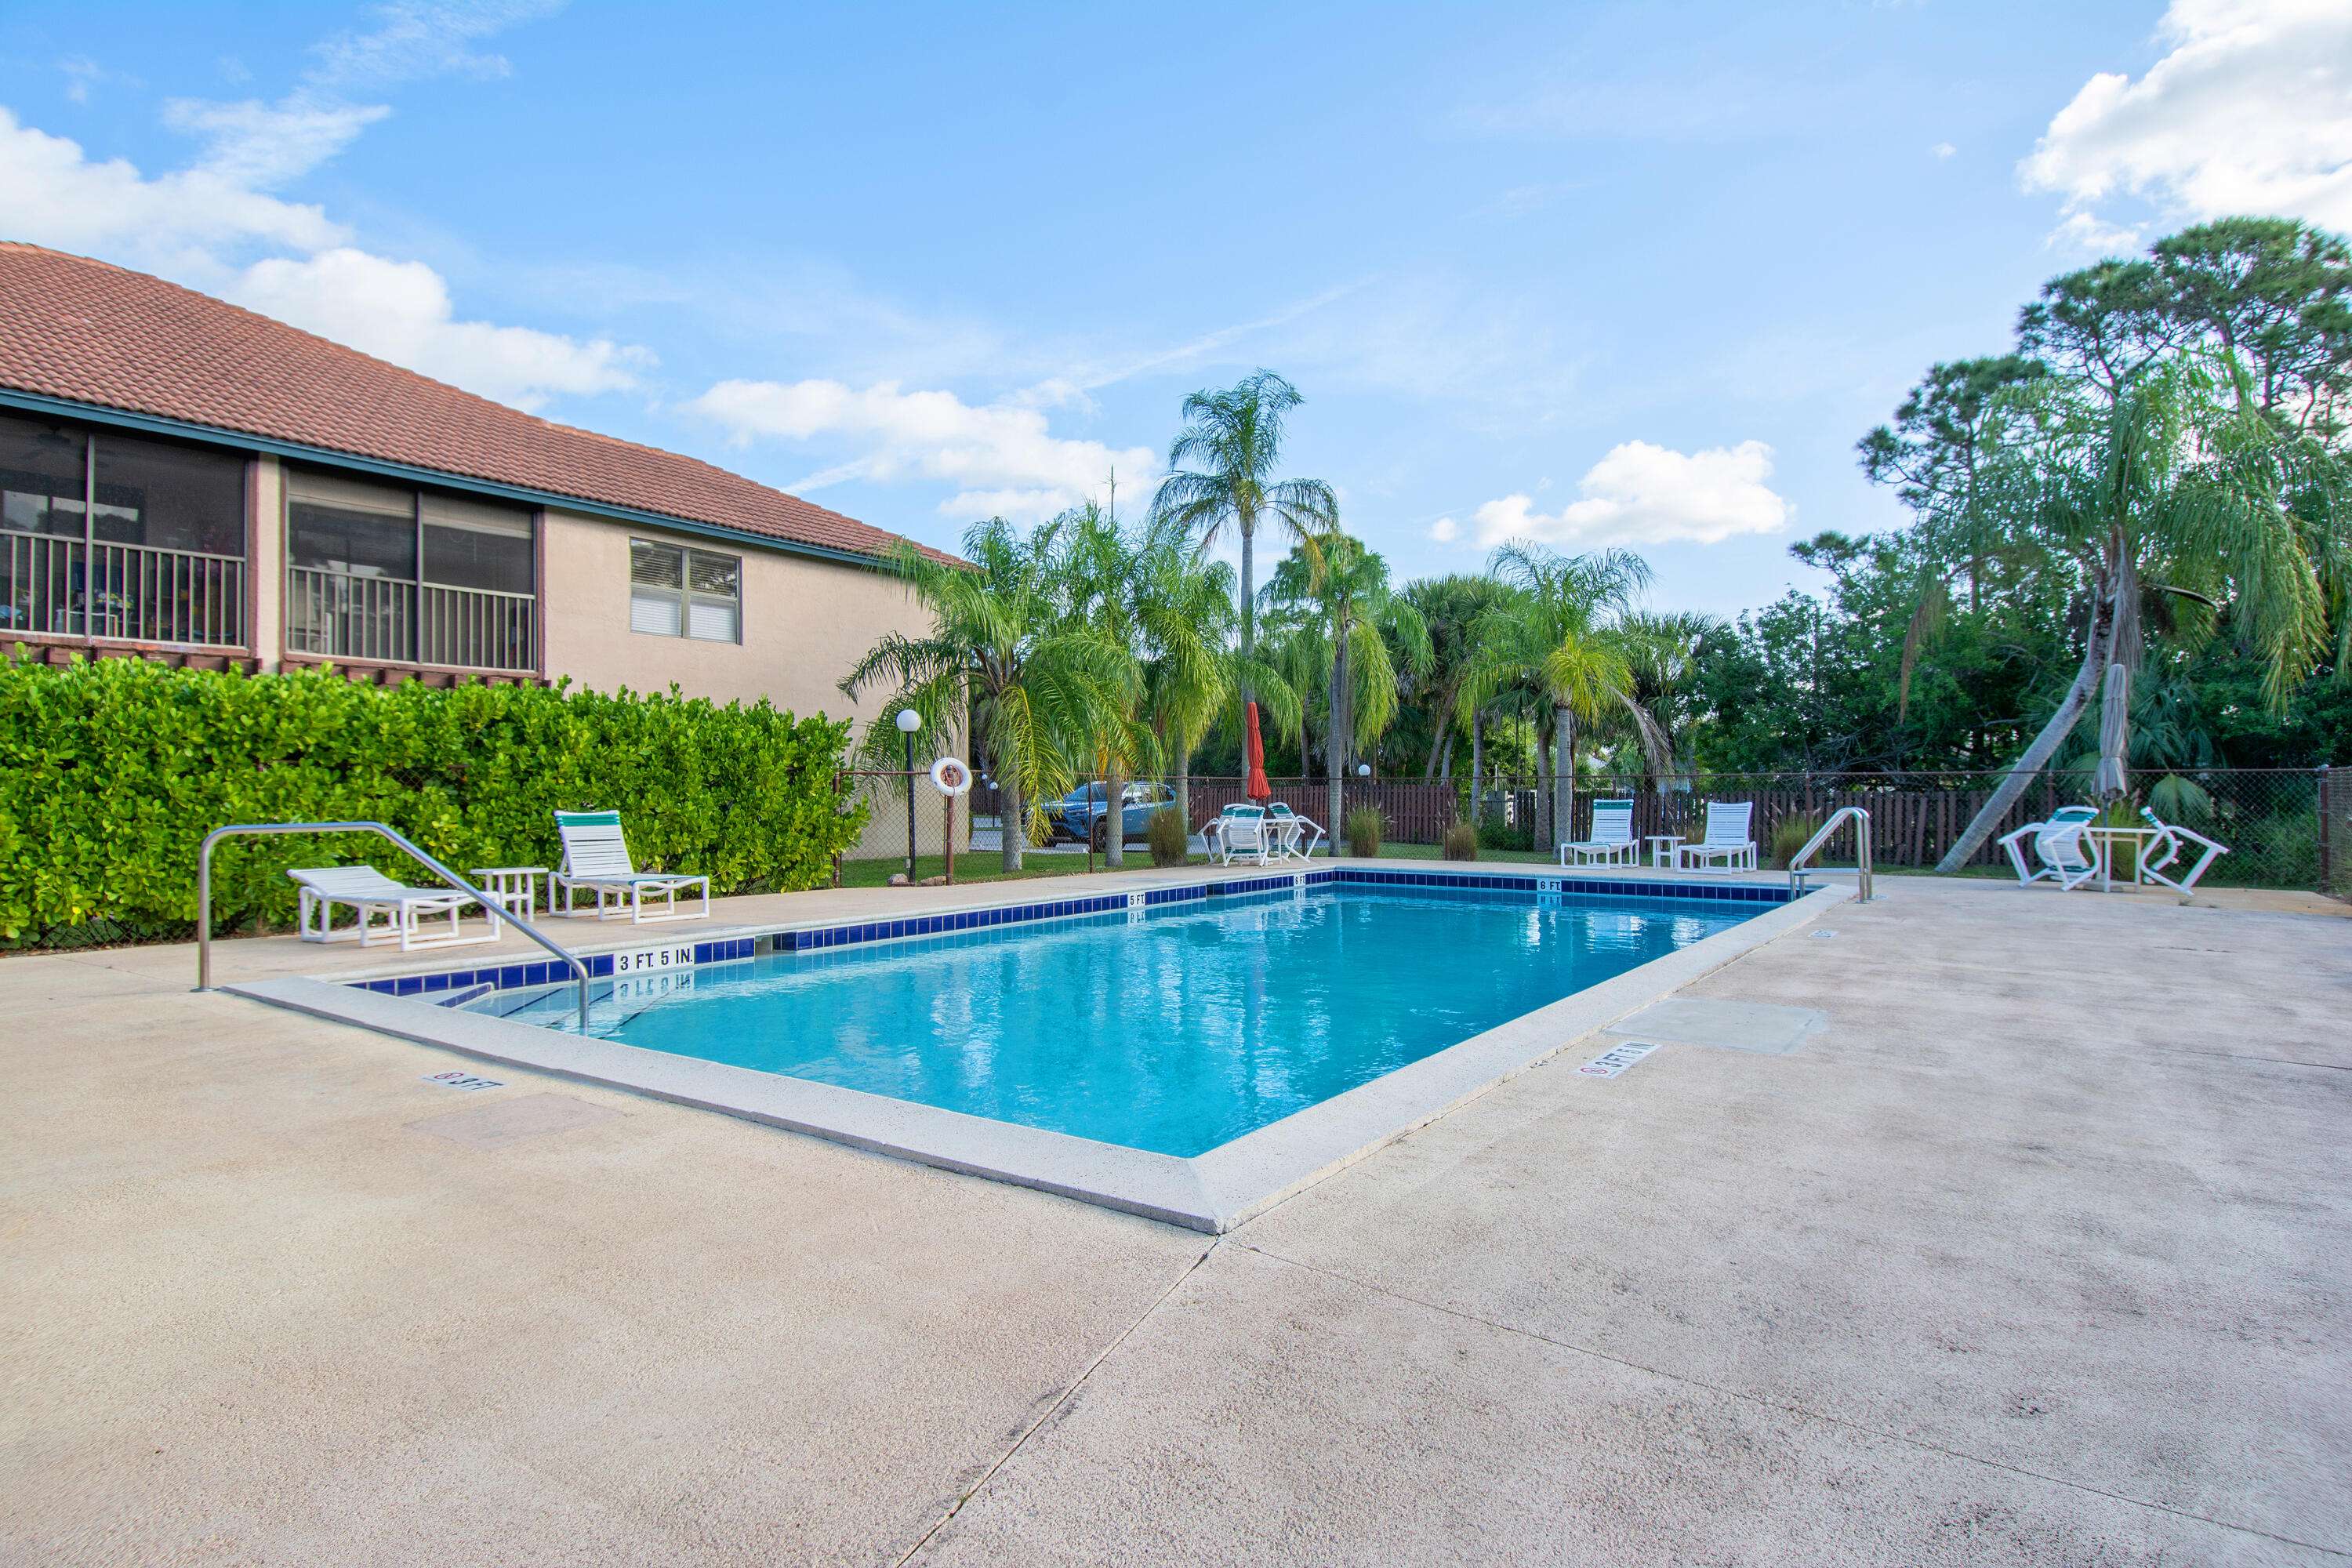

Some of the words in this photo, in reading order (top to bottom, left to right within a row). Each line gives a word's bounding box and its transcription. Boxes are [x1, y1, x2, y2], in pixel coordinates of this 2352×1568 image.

[1130, 895, 1134, 906] 5
[620, 956, 629, 971] 3
[636, 953, 654, 969] FT.
[661, 950, 670, 966] 5
[676, 948, 693, 964] IN.
